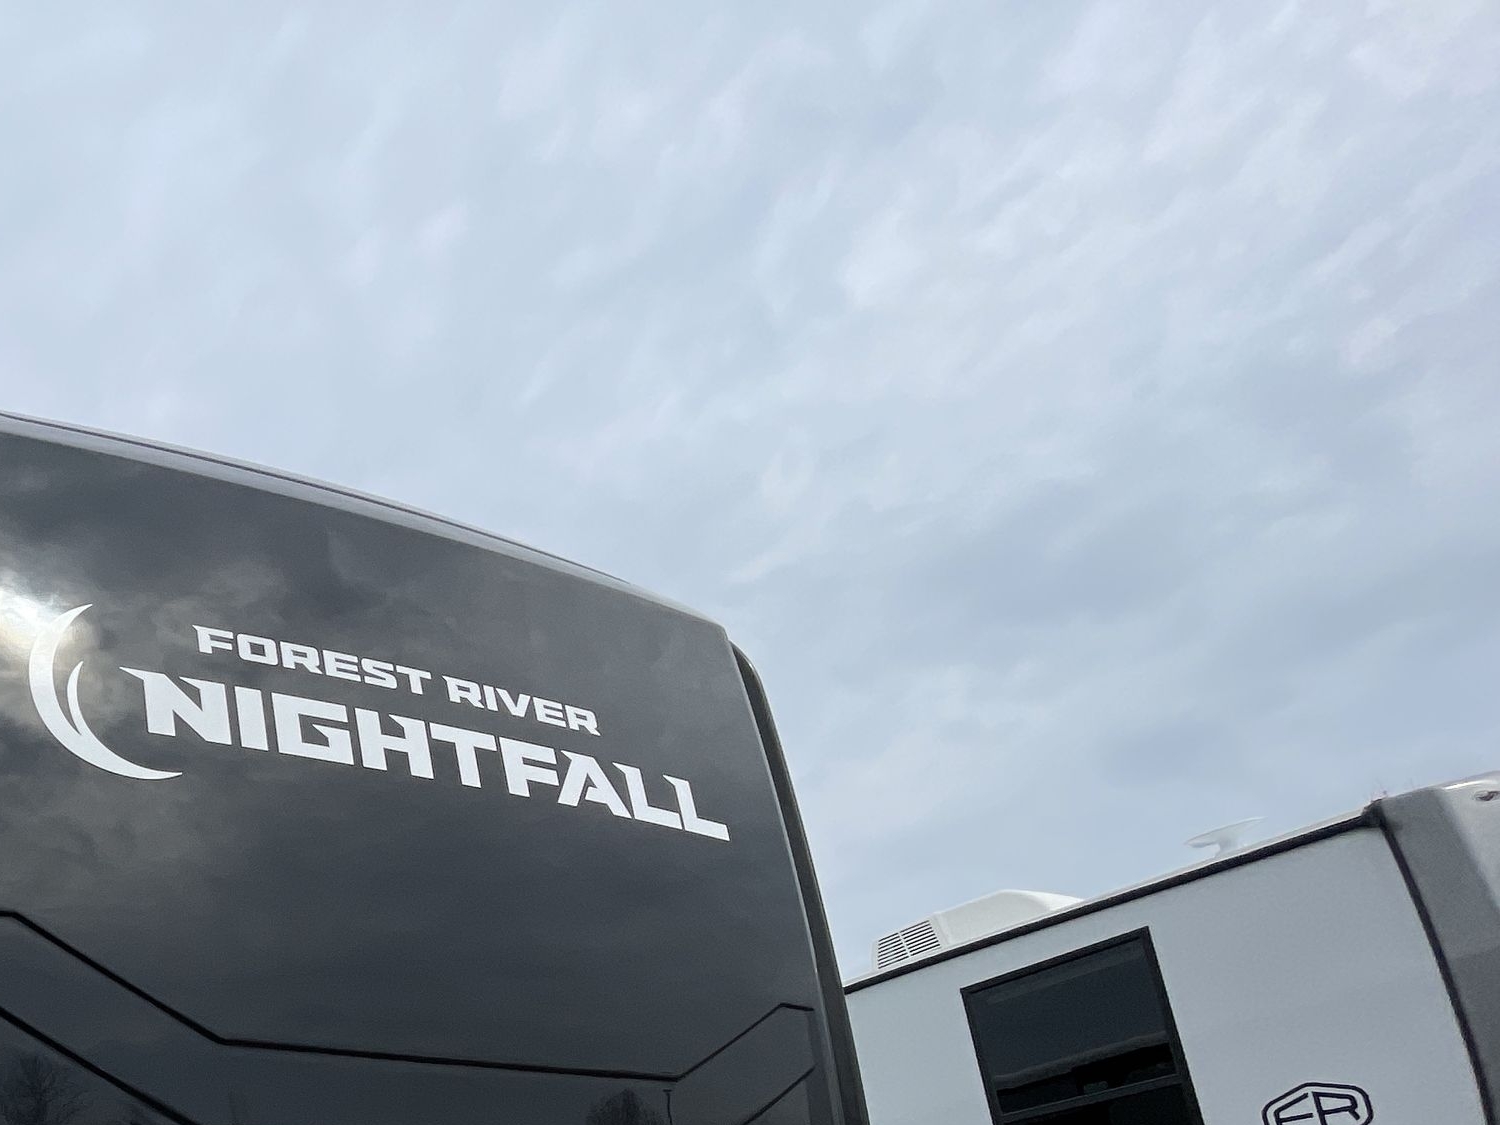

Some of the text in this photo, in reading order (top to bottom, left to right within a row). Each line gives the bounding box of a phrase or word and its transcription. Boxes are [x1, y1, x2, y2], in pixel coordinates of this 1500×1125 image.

[192, 624, 601, 737] FOREST RIVER
[119, 666, 730, 842] NIGHTFALL
